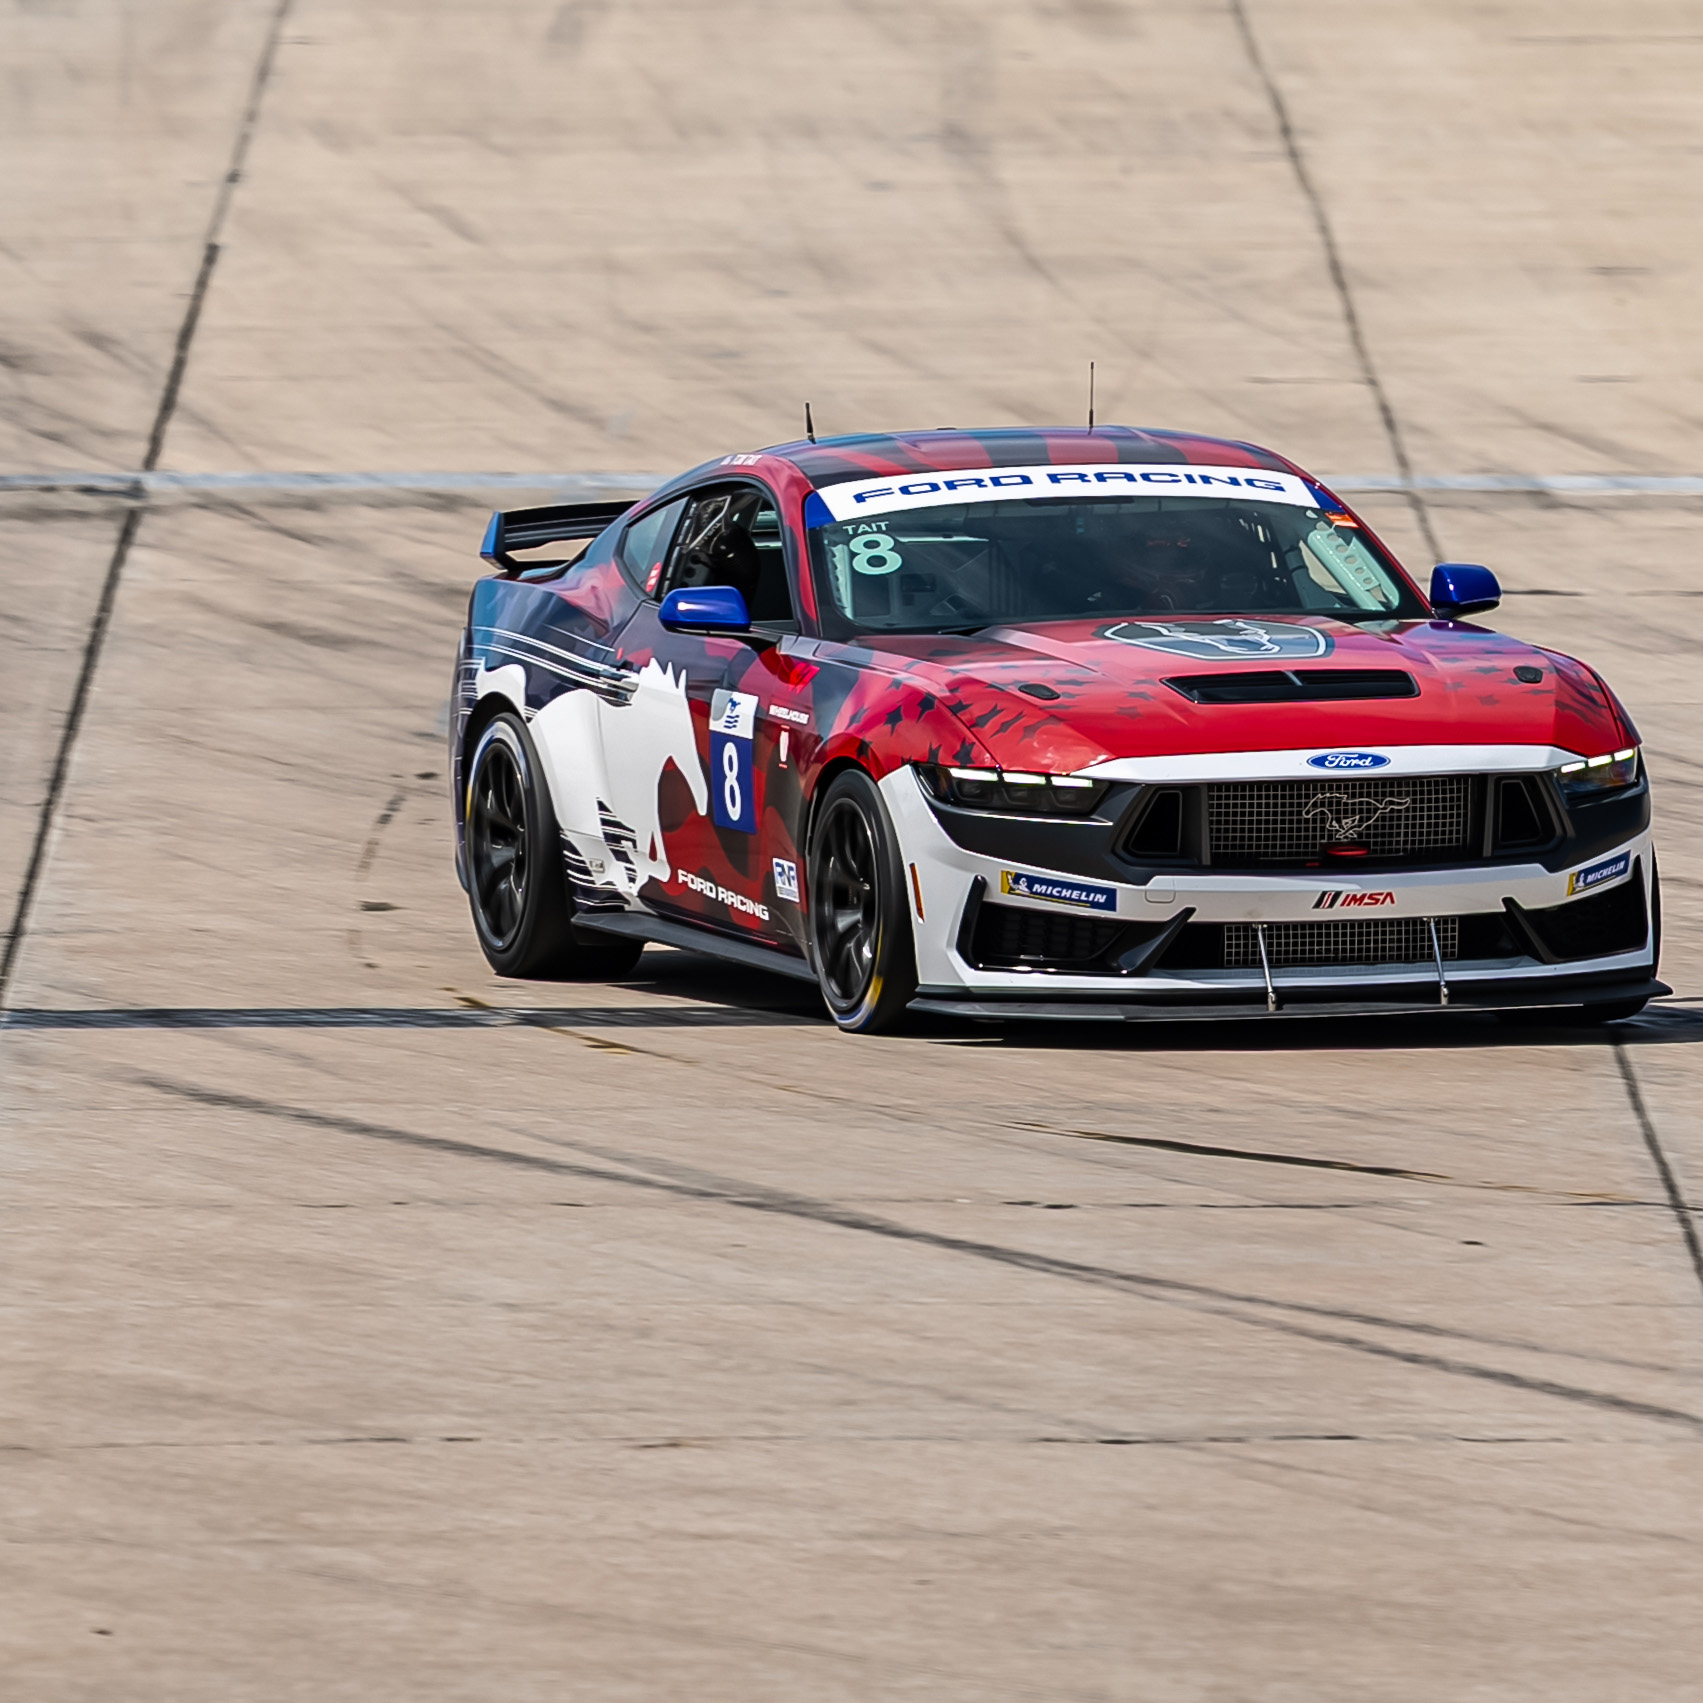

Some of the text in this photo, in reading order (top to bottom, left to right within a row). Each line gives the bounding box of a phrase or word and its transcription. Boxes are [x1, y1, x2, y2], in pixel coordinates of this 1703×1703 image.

[852, 471, 1288, 504] FORD RACING
[842, 521, 890, 536] TAIT
[848, 533, 903, 575] 8
[1324, 753, 1374, 768] Ford
[722, 741, 742, 822] 8
[1586, 860, 1626, 884] MICHELIN
[677, 869, 717, 899] FORD
[717, 886, 770, 921] RACING
[1032, 883, 1108, 903] MICHELIN
[1339, 891, 1396, 907] IMSA
